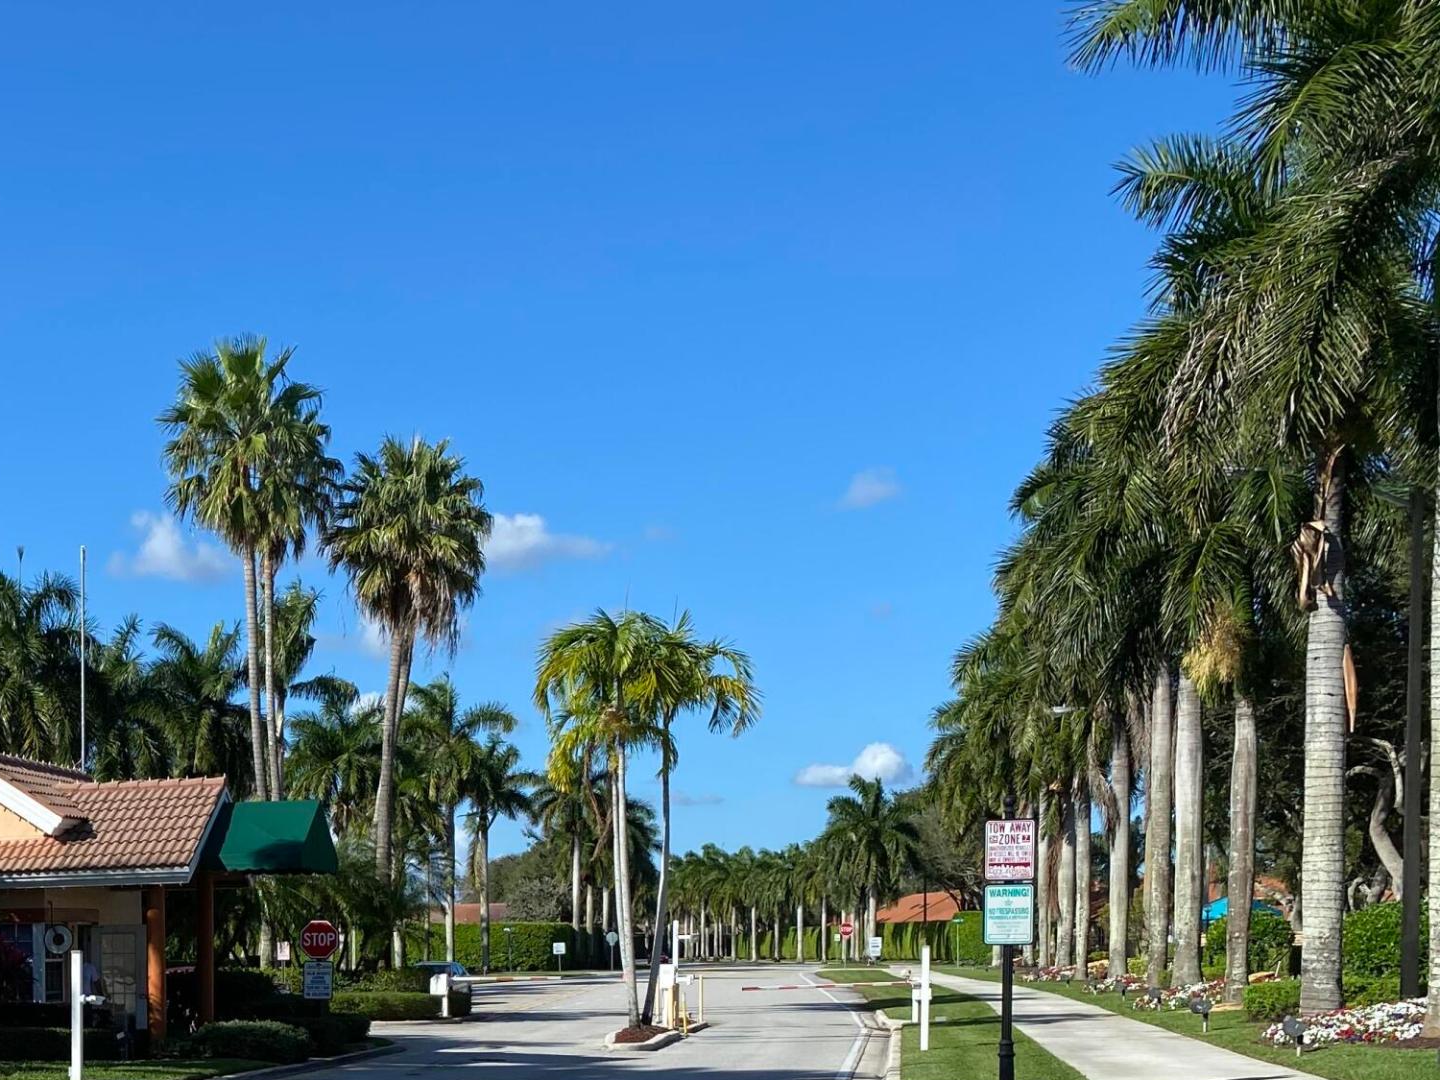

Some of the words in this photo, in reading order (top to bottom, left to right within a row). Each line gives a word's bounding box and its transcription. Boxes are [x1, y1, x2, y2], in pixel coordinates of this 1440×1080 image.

[989, 823, 1005, 833] TOW
[1010, 823, 1031, 833] AWAY
[999, 834, 1021, 845] ZONE
[989, 888, 1030, 897] WARNING!
[303, 932, 335, 946] STOP
